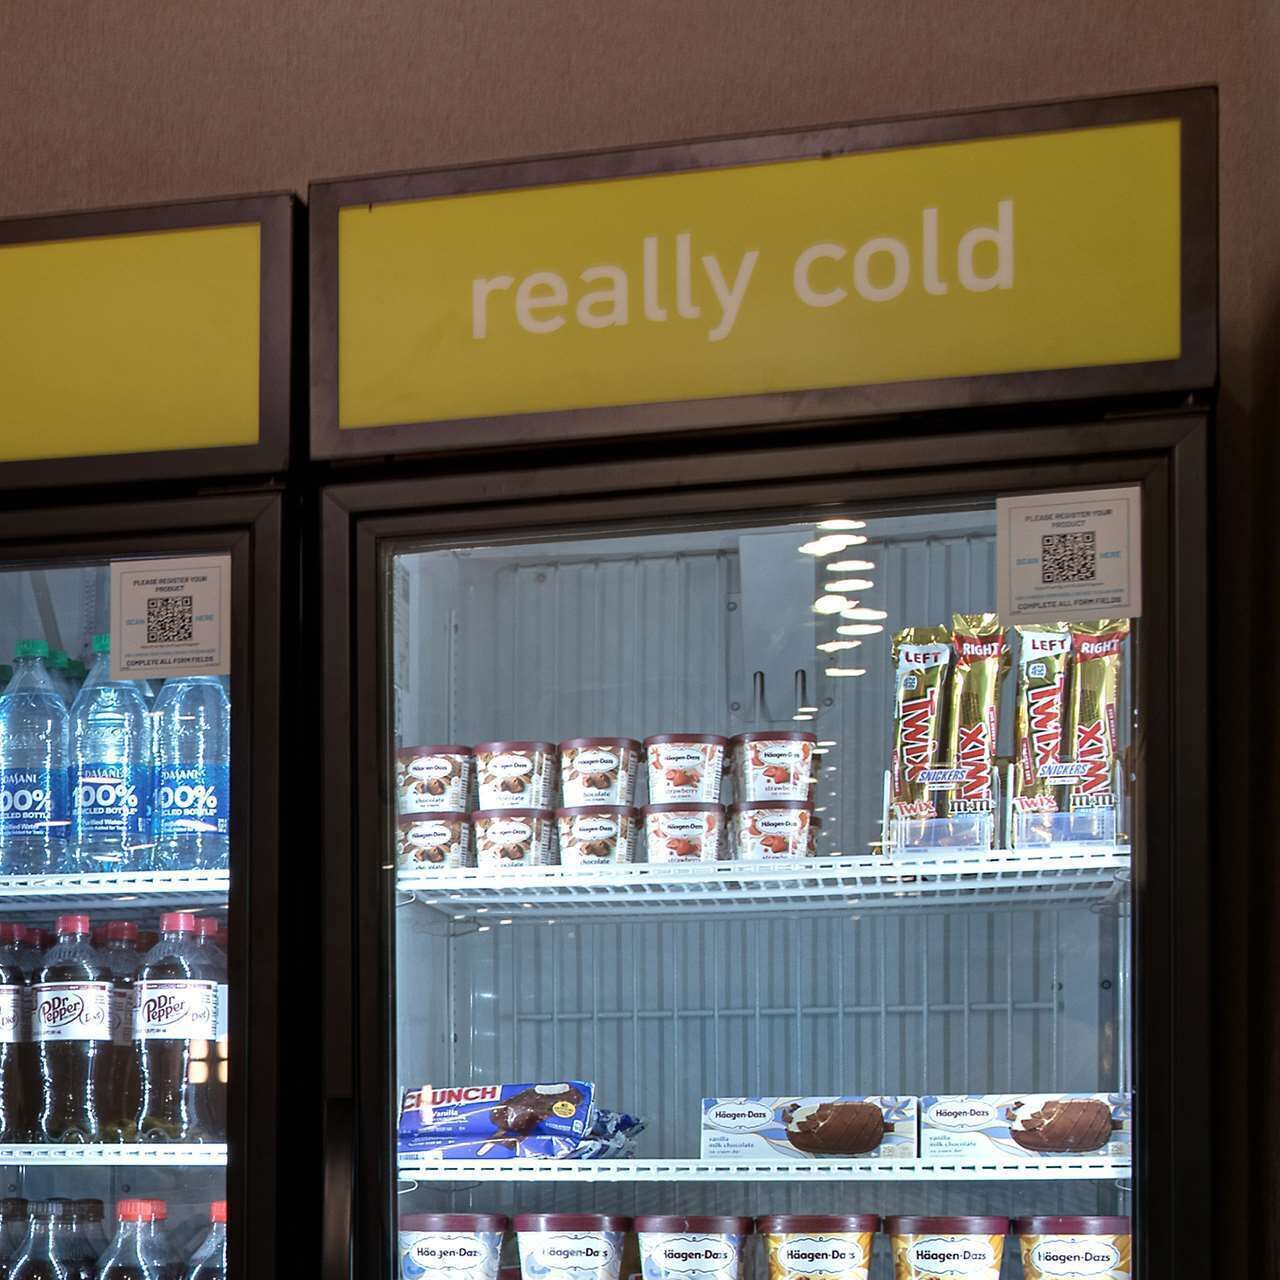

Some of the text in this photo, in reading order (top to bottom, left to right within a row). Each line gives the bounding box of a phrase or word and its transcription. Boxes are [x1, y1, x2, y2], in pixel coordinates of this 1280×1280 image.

[471, 201, 1016, 342] really cold
[962, 643, 999, 657] RIGHT
[1031, 639, 1066, 651] LEFT
[1081, 639, 1121, 653] RIGHT
[905, 652, 941, 664] LEFT
[1028, 674, 1066, 766] TWIX
[900, 687, 936, 782] TWIX
[918, 769, 967, 782] SNICKERS
[1040, 764, 1088, 777] SNICKERS
[3, 773, 38, 785] DASANI
[73, 785, 138, 808] 100%
[714, 1108, 767, 1123] Häagen-Dazs
[935, 1107, 990, 1122] Häagen-Dazs
